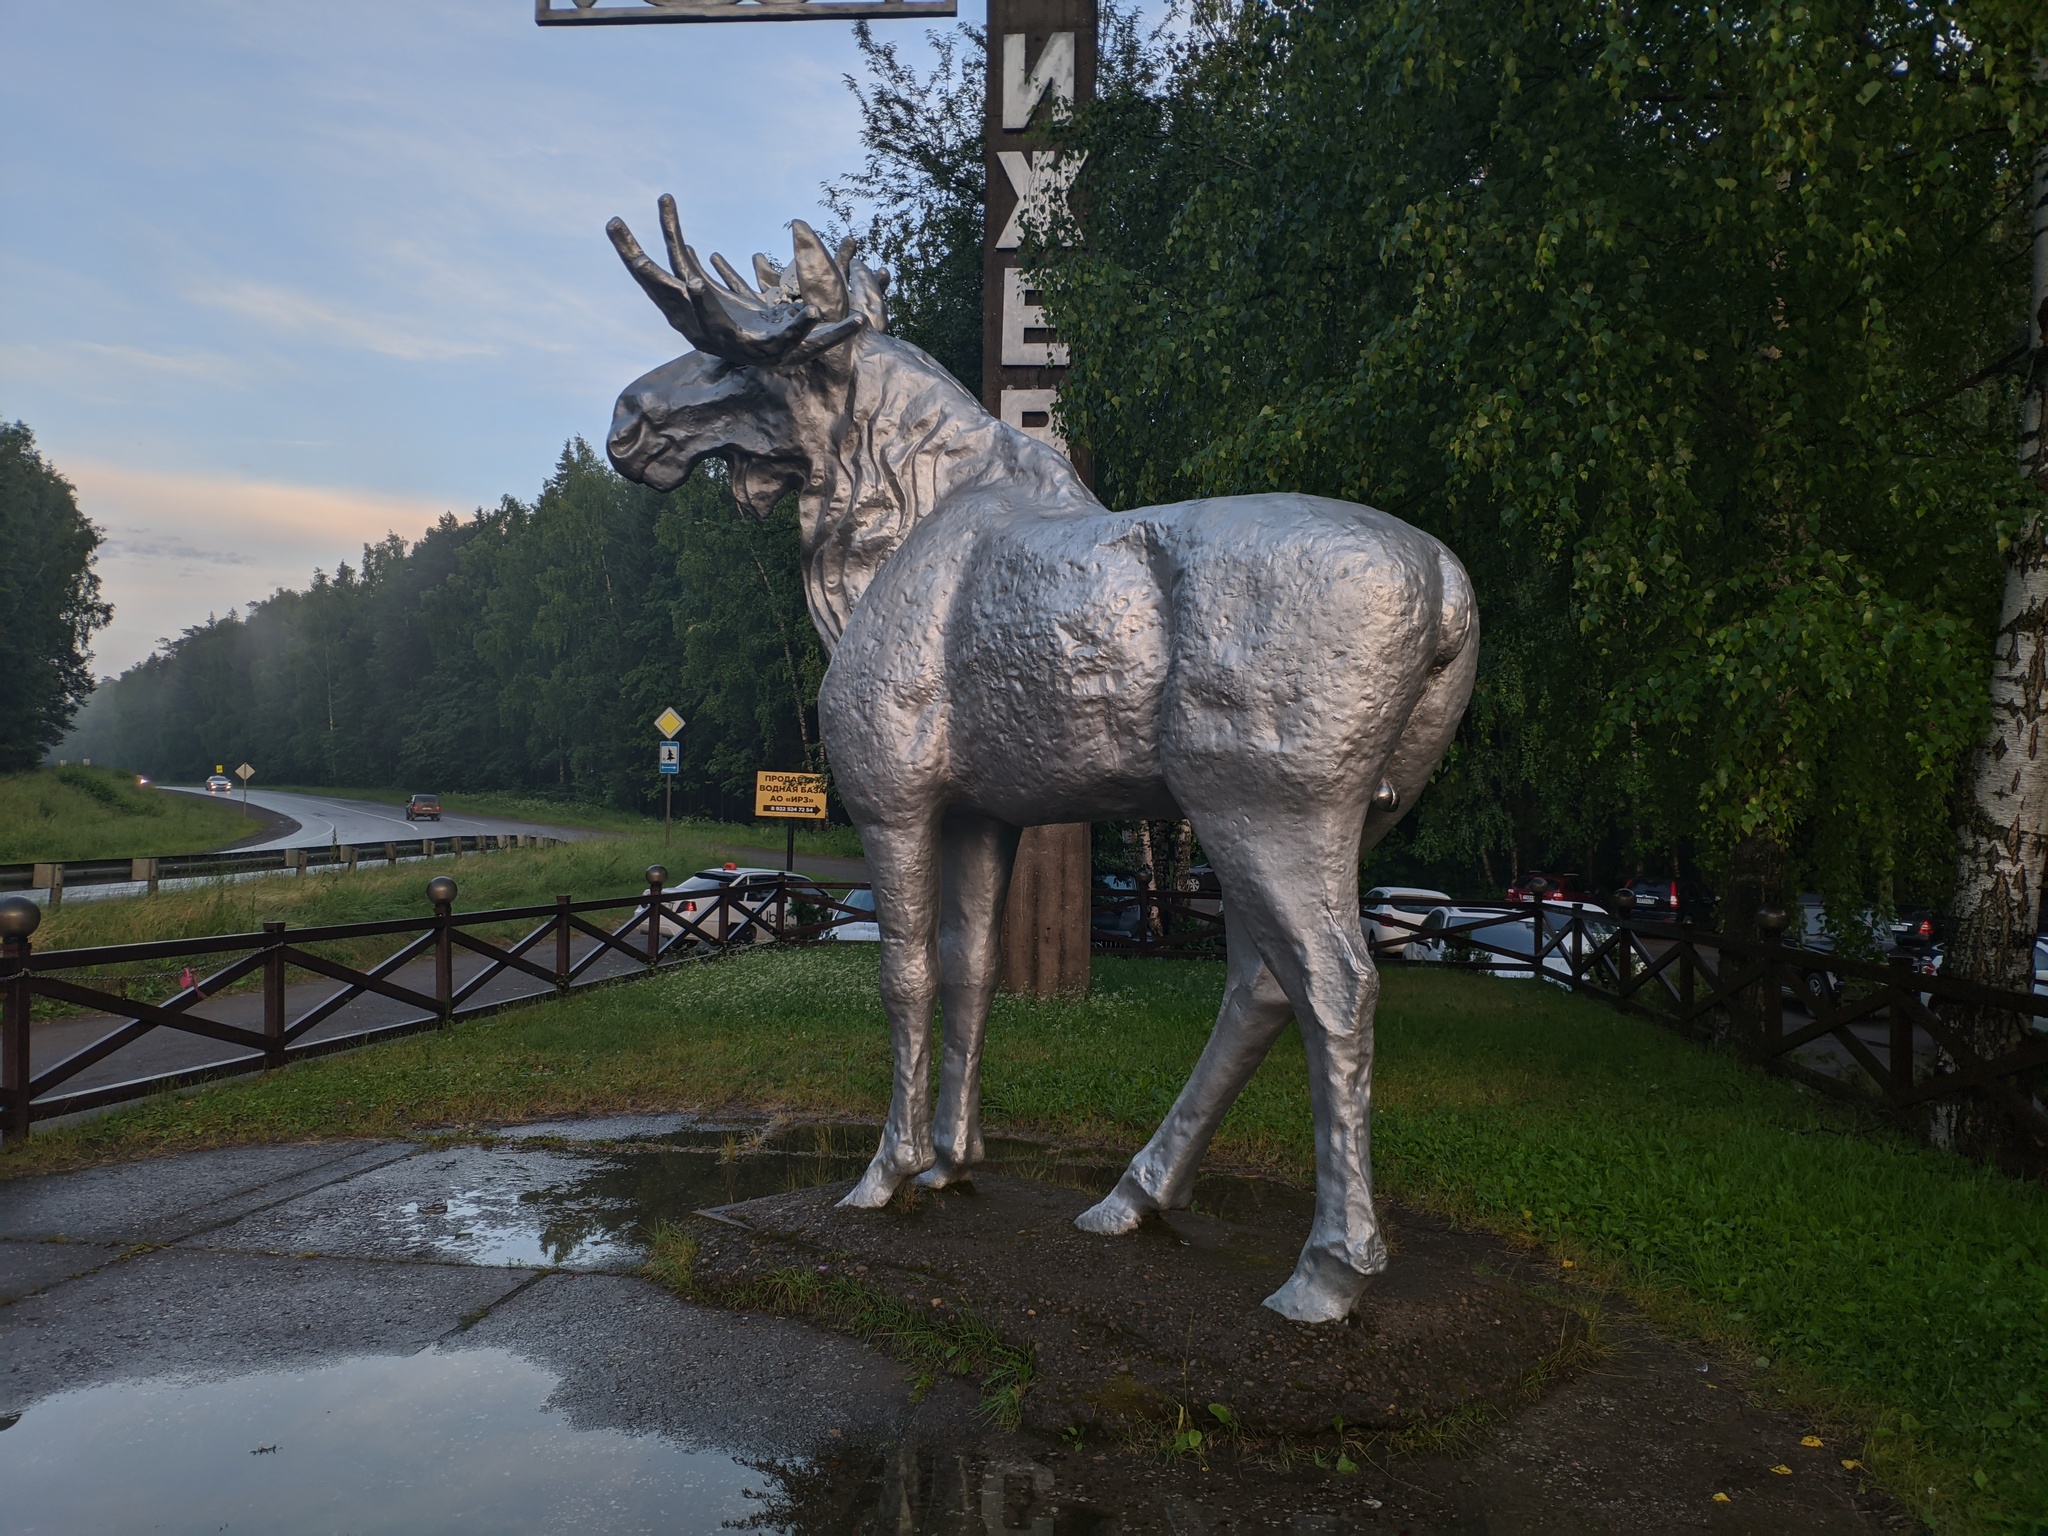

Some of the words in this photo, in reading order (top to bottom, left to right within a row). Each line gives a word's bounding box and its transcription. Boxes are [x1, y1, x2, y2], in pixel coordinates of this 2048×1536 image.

[759, 785, 798, 793] ВОДНАЯ
[801, 786, 827, 794] БАЗА
[786, 796, 814, 804] «ИРЗ»
